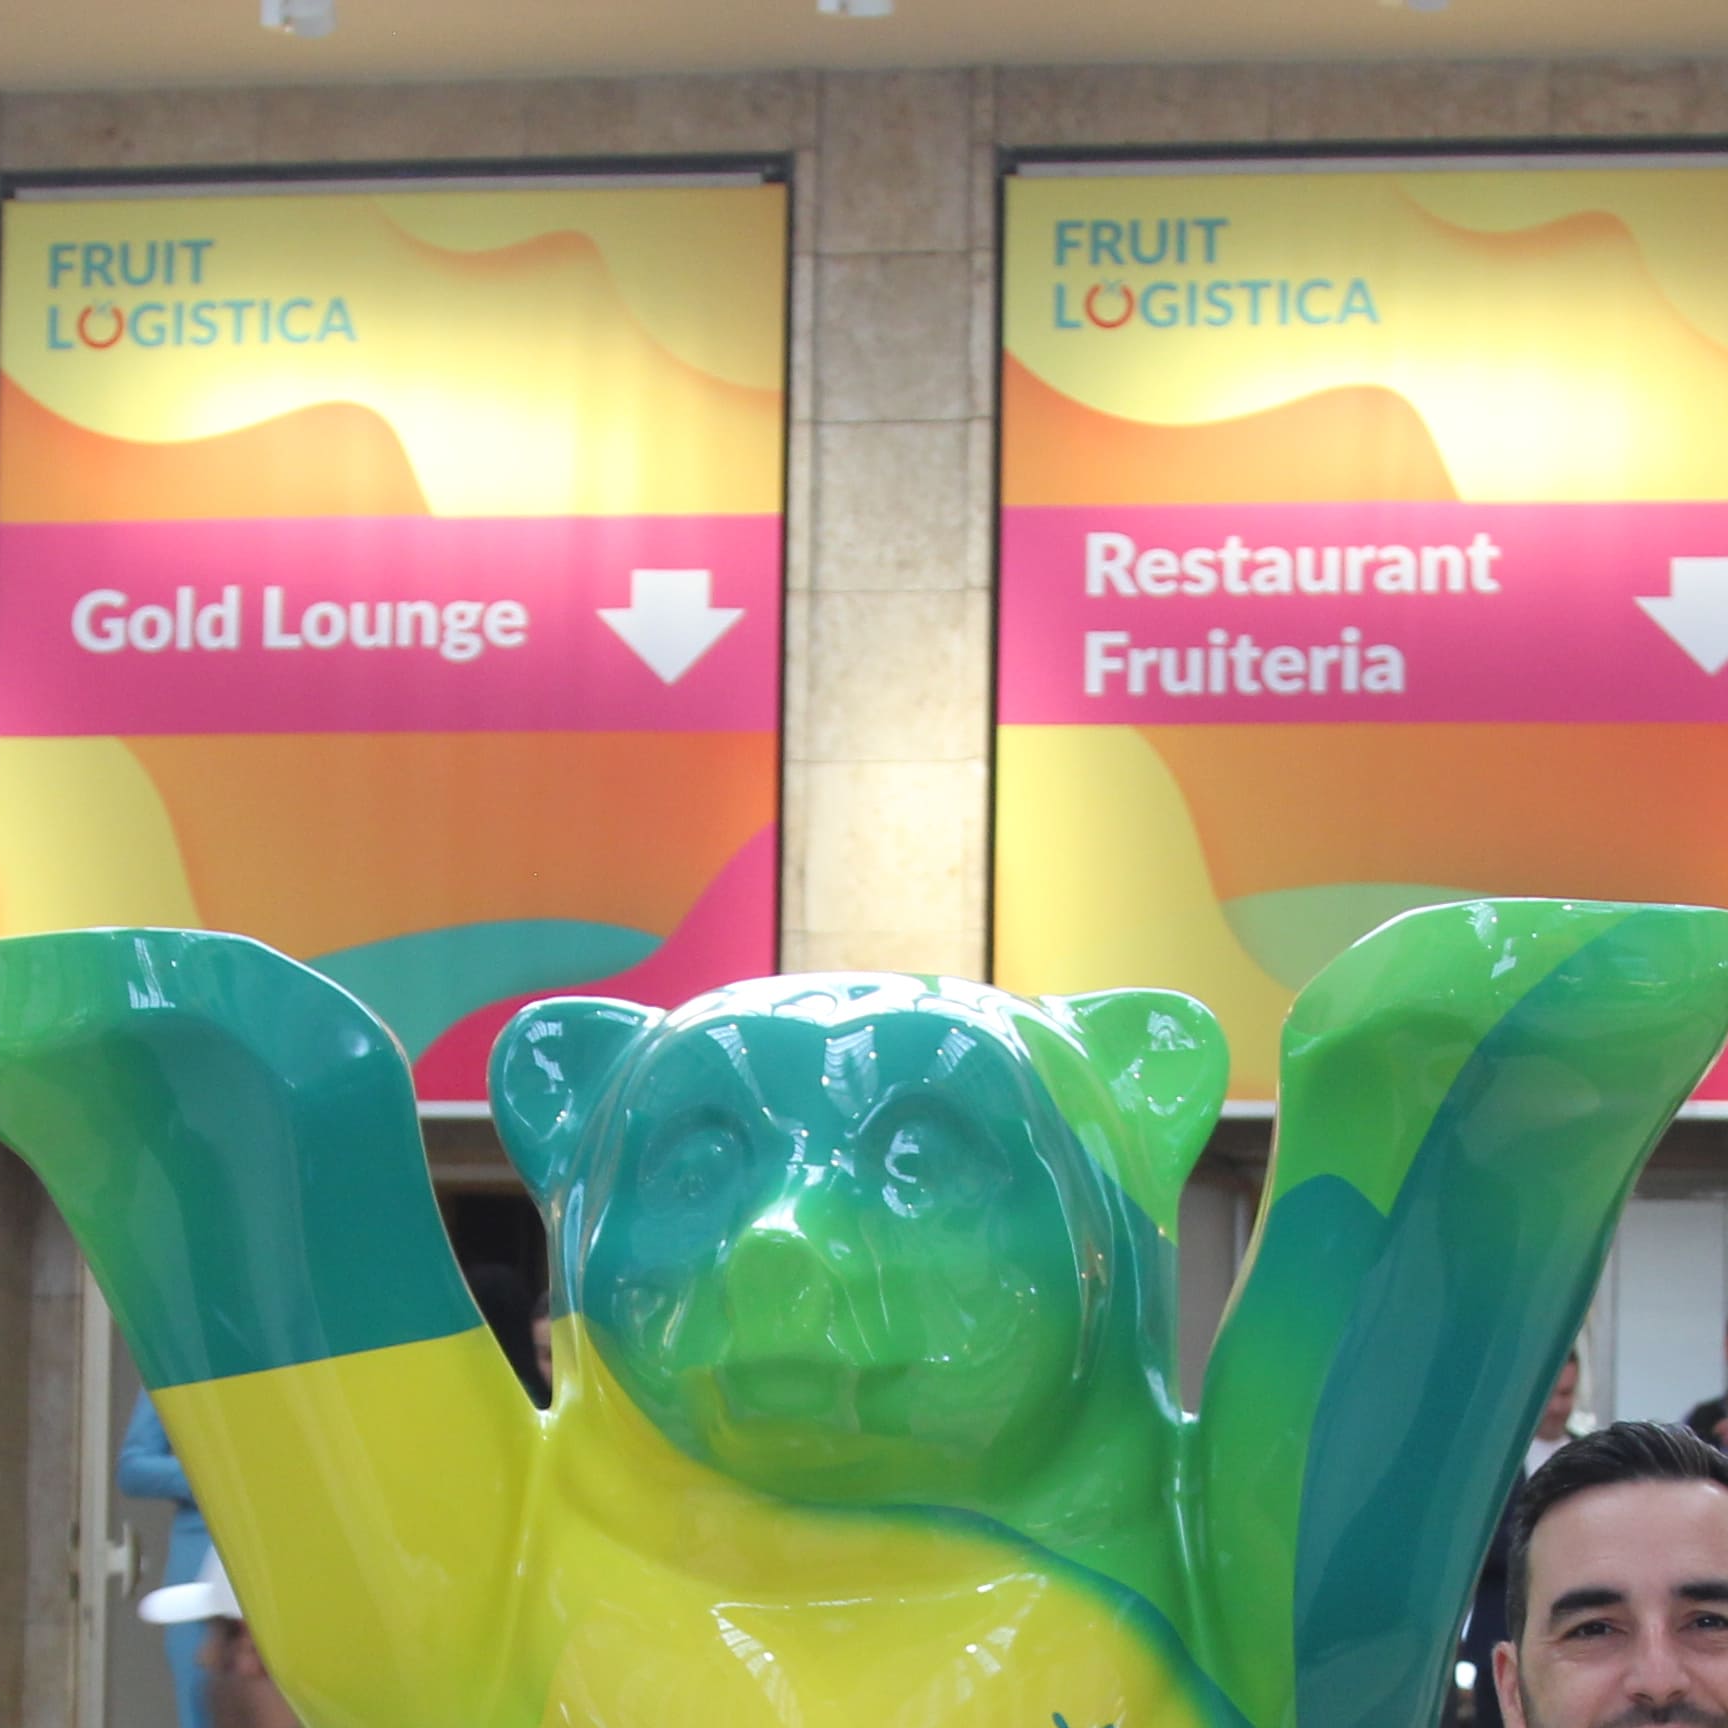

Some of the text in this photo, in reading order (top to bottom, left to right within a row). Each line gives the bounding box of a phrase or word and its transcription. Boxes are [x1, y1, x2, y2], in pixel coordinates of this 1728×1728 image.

[47, 239, 214, 288] FRUIT
[1053, 217, 1229, 266] FRUIT
[47, 297, 358, 350] LOGISTICA
[1053, 277, 1381, 330] LOGISTICA
[1085, 532, 1501, 597] Restaurant
[71, 584, 529, 662] Gold Lounge
[1084, 628, 1405, 696] Fruiteria
